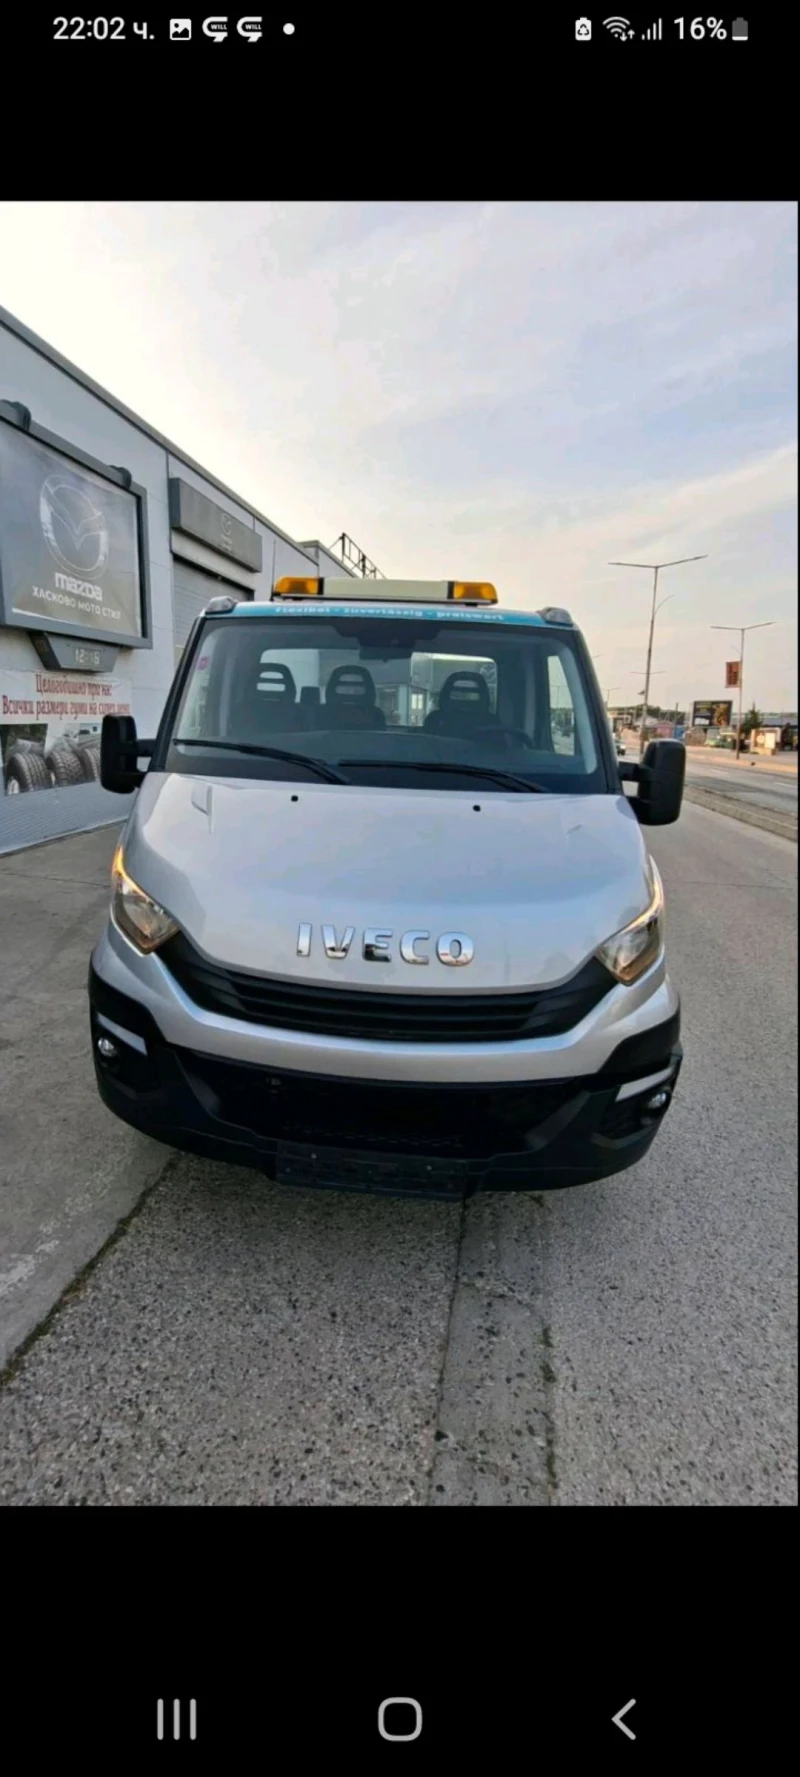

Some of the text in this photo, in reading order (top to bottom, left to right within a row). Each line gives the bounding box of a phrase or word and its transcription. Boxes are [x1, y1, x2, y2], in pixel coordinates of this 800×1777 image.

[32, 585, 76, 608] ХАСКОВО
[77, 601, 101, 615] МОТО
[54, 572, 103, 601] mazda
[2, 695, 34, 714] Всички
[296, 922, 475, 967] IVECO
